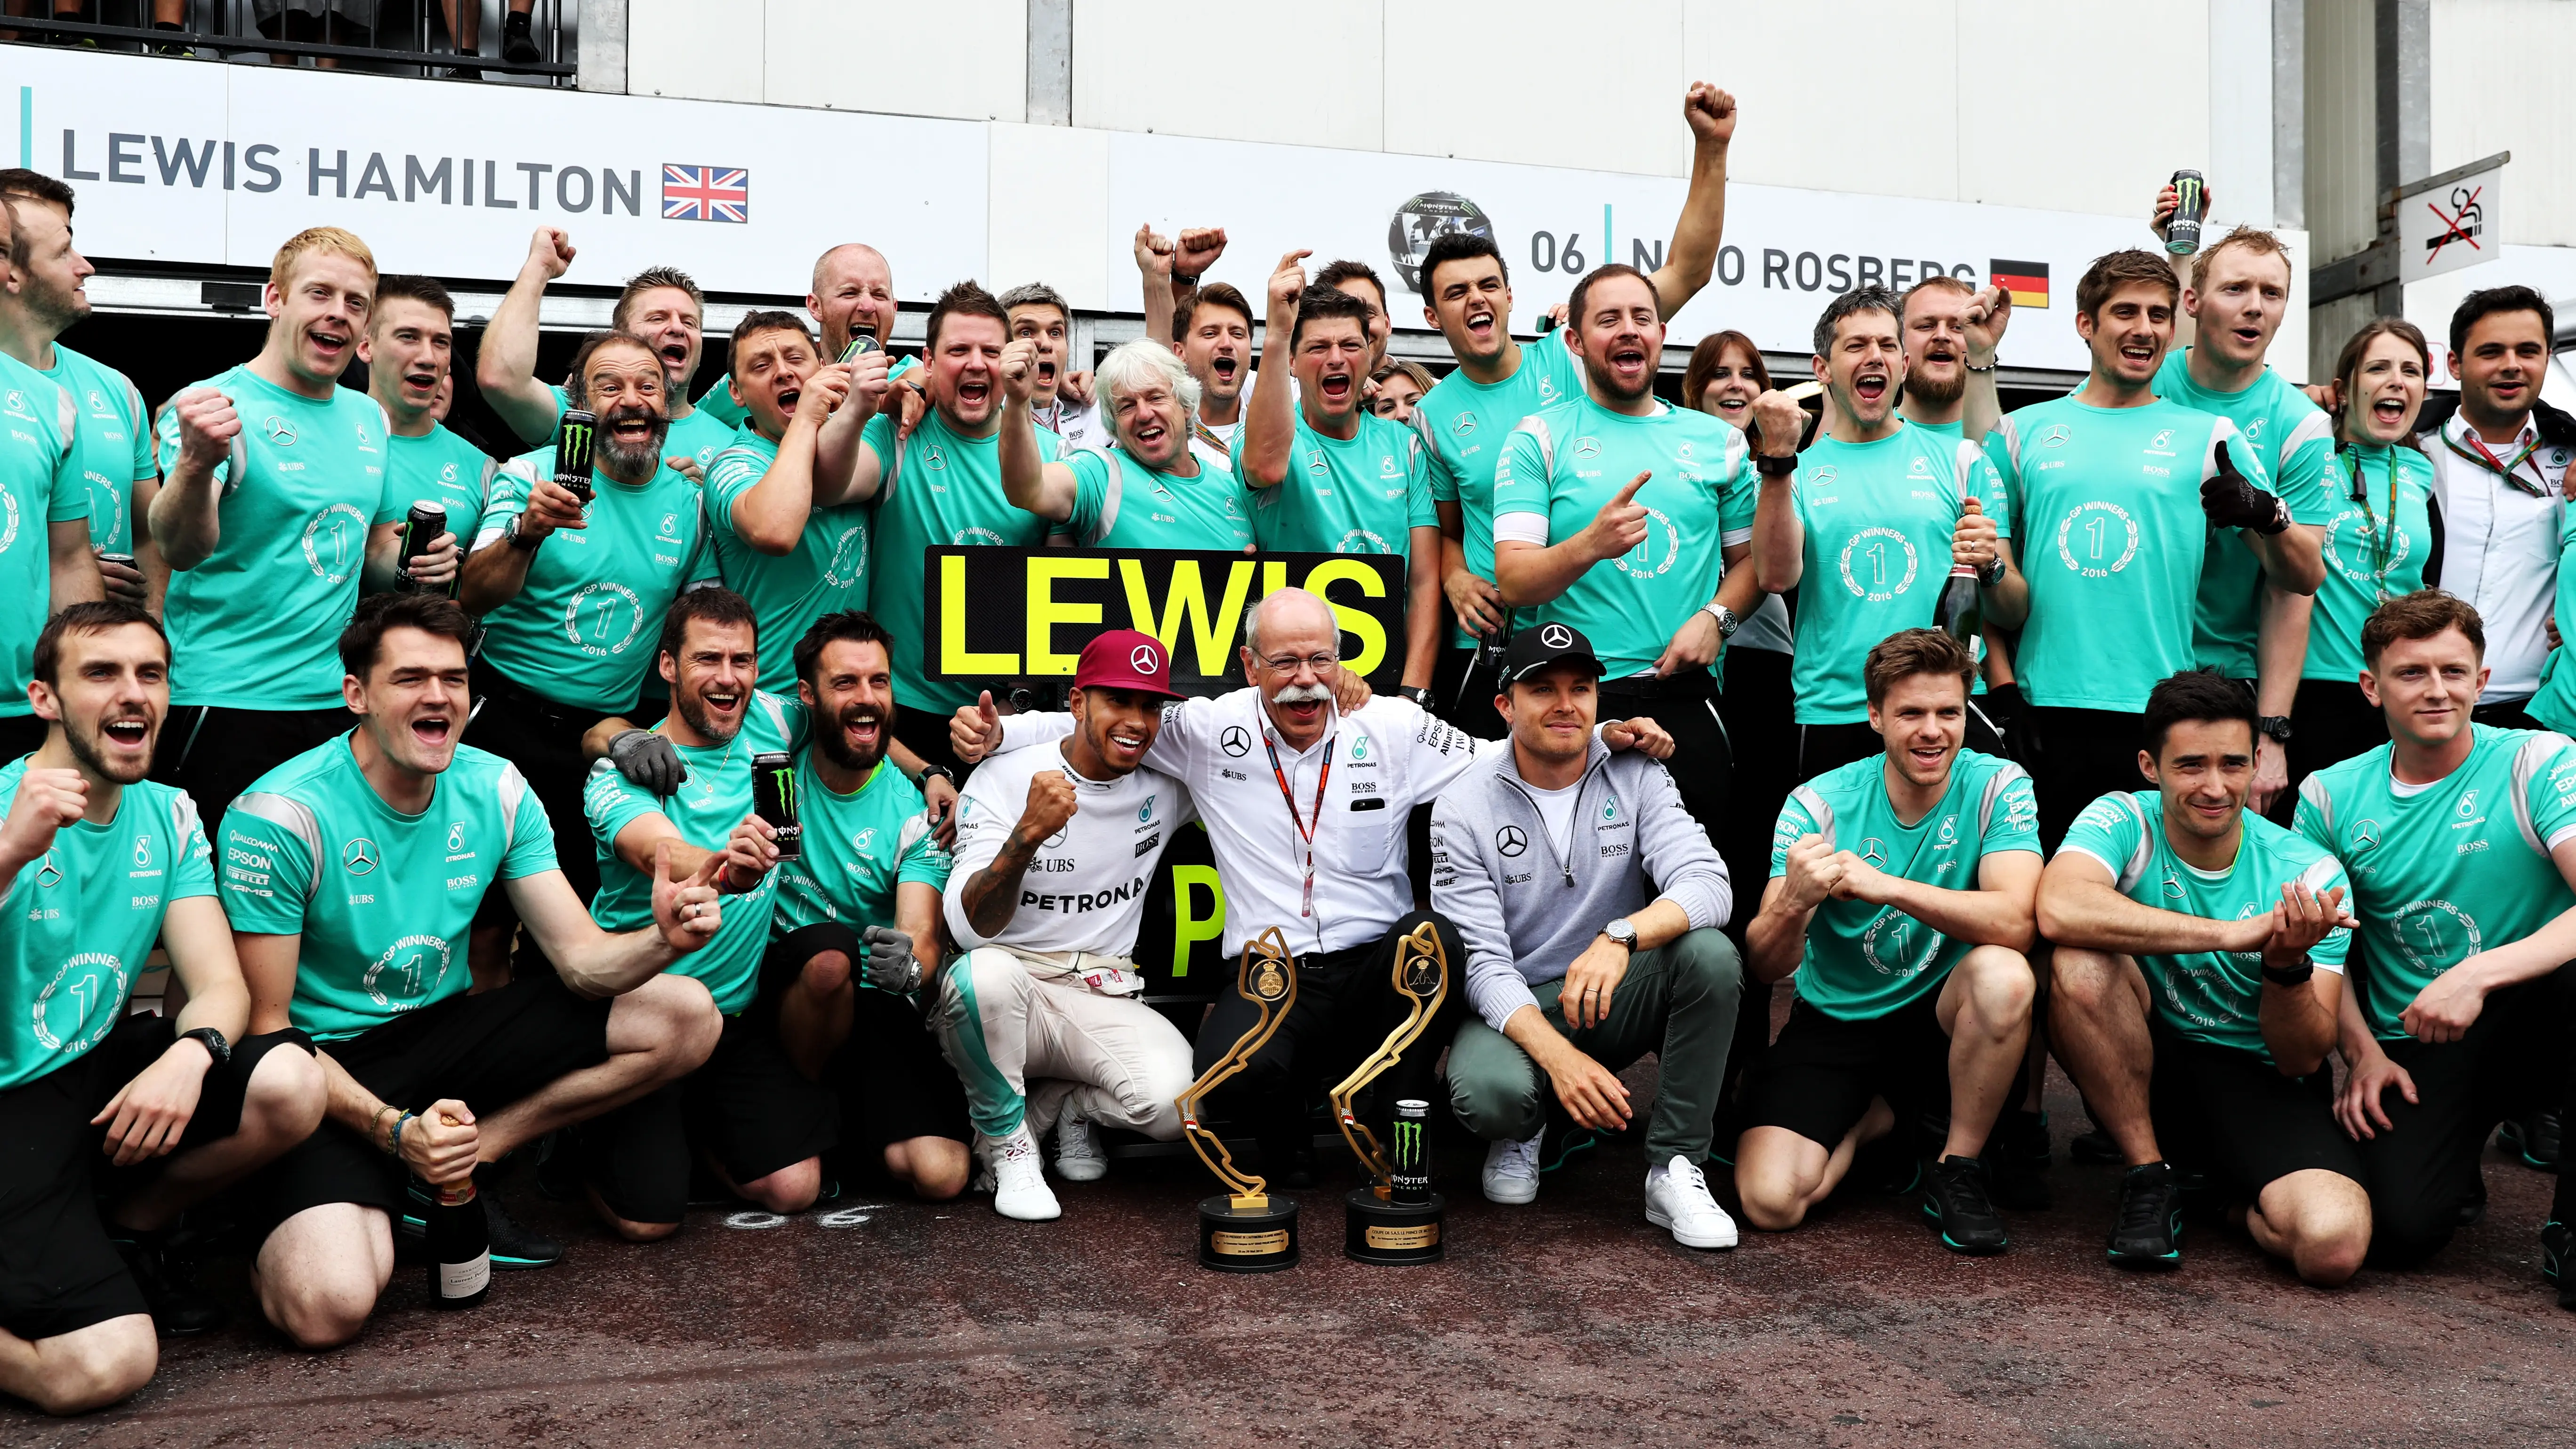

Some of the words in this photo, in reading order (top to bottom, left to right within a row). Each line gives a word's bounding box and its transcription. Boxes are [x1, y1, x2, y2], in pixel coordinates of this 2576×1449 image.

[63, 129, 282, 193] LEWIS
[308, 148, 641, 216] HAMILTON
[1531, 230, 1586, 274] 06
[1633, 238, 1745, 286] NO
[4, 410, 38, 423] PETRONAS
[11, 429, 37, 443] BOSS
[104, 431, 124, 440] BOSS
[1069, 428, 1084, 438] BOSS
[1467, 444, 1481, 454] UBS
[2143, 449, 2177, 457] PETRONAS
[288, 462, 305, 471] UBS
[2049, 460, 2065, 469] UBS
[2142, 465, 2171, 476] BOSS
[1678, 471, 1703, 480] BOSS
[437, 481, 466, 491] PETRONAS
[931, 484, 946, 493] UBS
[1911, 490, 1936, 498] BOSS
[442, 497, 466, 509] BOSS
[1821, 496, 1838, 505] UBS
[317, 509, 328, 522] GP
[330, 503, 365, 523] WINNERS
[2069, 506, 2082, 519] GP
[2085, 500, 2130, 521] WINNERS
[1160, 514, 1175, 523] UBS
[569, 534, 587, 545] UBS
[655, 535, 683, 545] PETRONAS
[1850, 532, 1861, 547] GP
[1861, 527, 1906, 544] WINNERS
[2085, 516, 2105, 560] 1
[655, 554, 678, 565] BOSS
[1866, 542, 1885, 585] 1
[1631, 569, 1654, 580] 2016
[2081, 567, 2108, 578] 2016
[2344, 568, 2370, 581] 2016
[840, 576, 855, 589] 2016
[584, 583, 598, 595] GP
[599, 582, 639, 606] WINNERS
[1867, 591, 1892, 602] 2016
[595, 598, 616, 640] 1
[941, 555, 1386, 677] LEWS
[581, 644, 607, 657] 2016
[1232, 771, 1247, 781] UBS
[1352, 781, 1377, 790] BOSS
[1135, 819, 1161, 835] PETRONAS
[1598, 821, 1630, 831] PETRONAS
[1136, 833, 1159, 854] BOSS
[1601, 843, 1628, 855] BOSS
[2457, 838, 2489, 853] BOSS
[227, 847, 272, 870] EPSON
[445, 852, 475, 862] ETRONAS
[847, 862, 871, 876] BOSS
[1046, 858, 1075, 872] UBS
[2359, 865, 2376, 874] UBS
[129, 869, 162, 878] PETRONAS
[226, 864, 270, 886] PIRELLI
[1515, 872, 1532, 882] UBS
[446, 874, 477, 888] BOSS
[1434, 877, 1458, 886] BOSE
[230, 884, 274, 898] AMG
[792, 874, 830, 904] WINNERS
[132, 895, 159, 907] BOSS
[354, 894, 375, 904] UBS
[745, 889, 765, 902] 2016
[44, 909, 59, 919] UBS
[2394, 906, 2406, 920] GP
[2406, 899, 2458, 916] WINNERS
[1873, 918, 1886, 930] GP
[383, 945, 396, 962] GP
[395, 934, 447, 951] WINNERS
[56, 964, 68, 981] GP
[401, 953, 422, 995] 1
[2188, 1013, 2216, 1027] 2016
